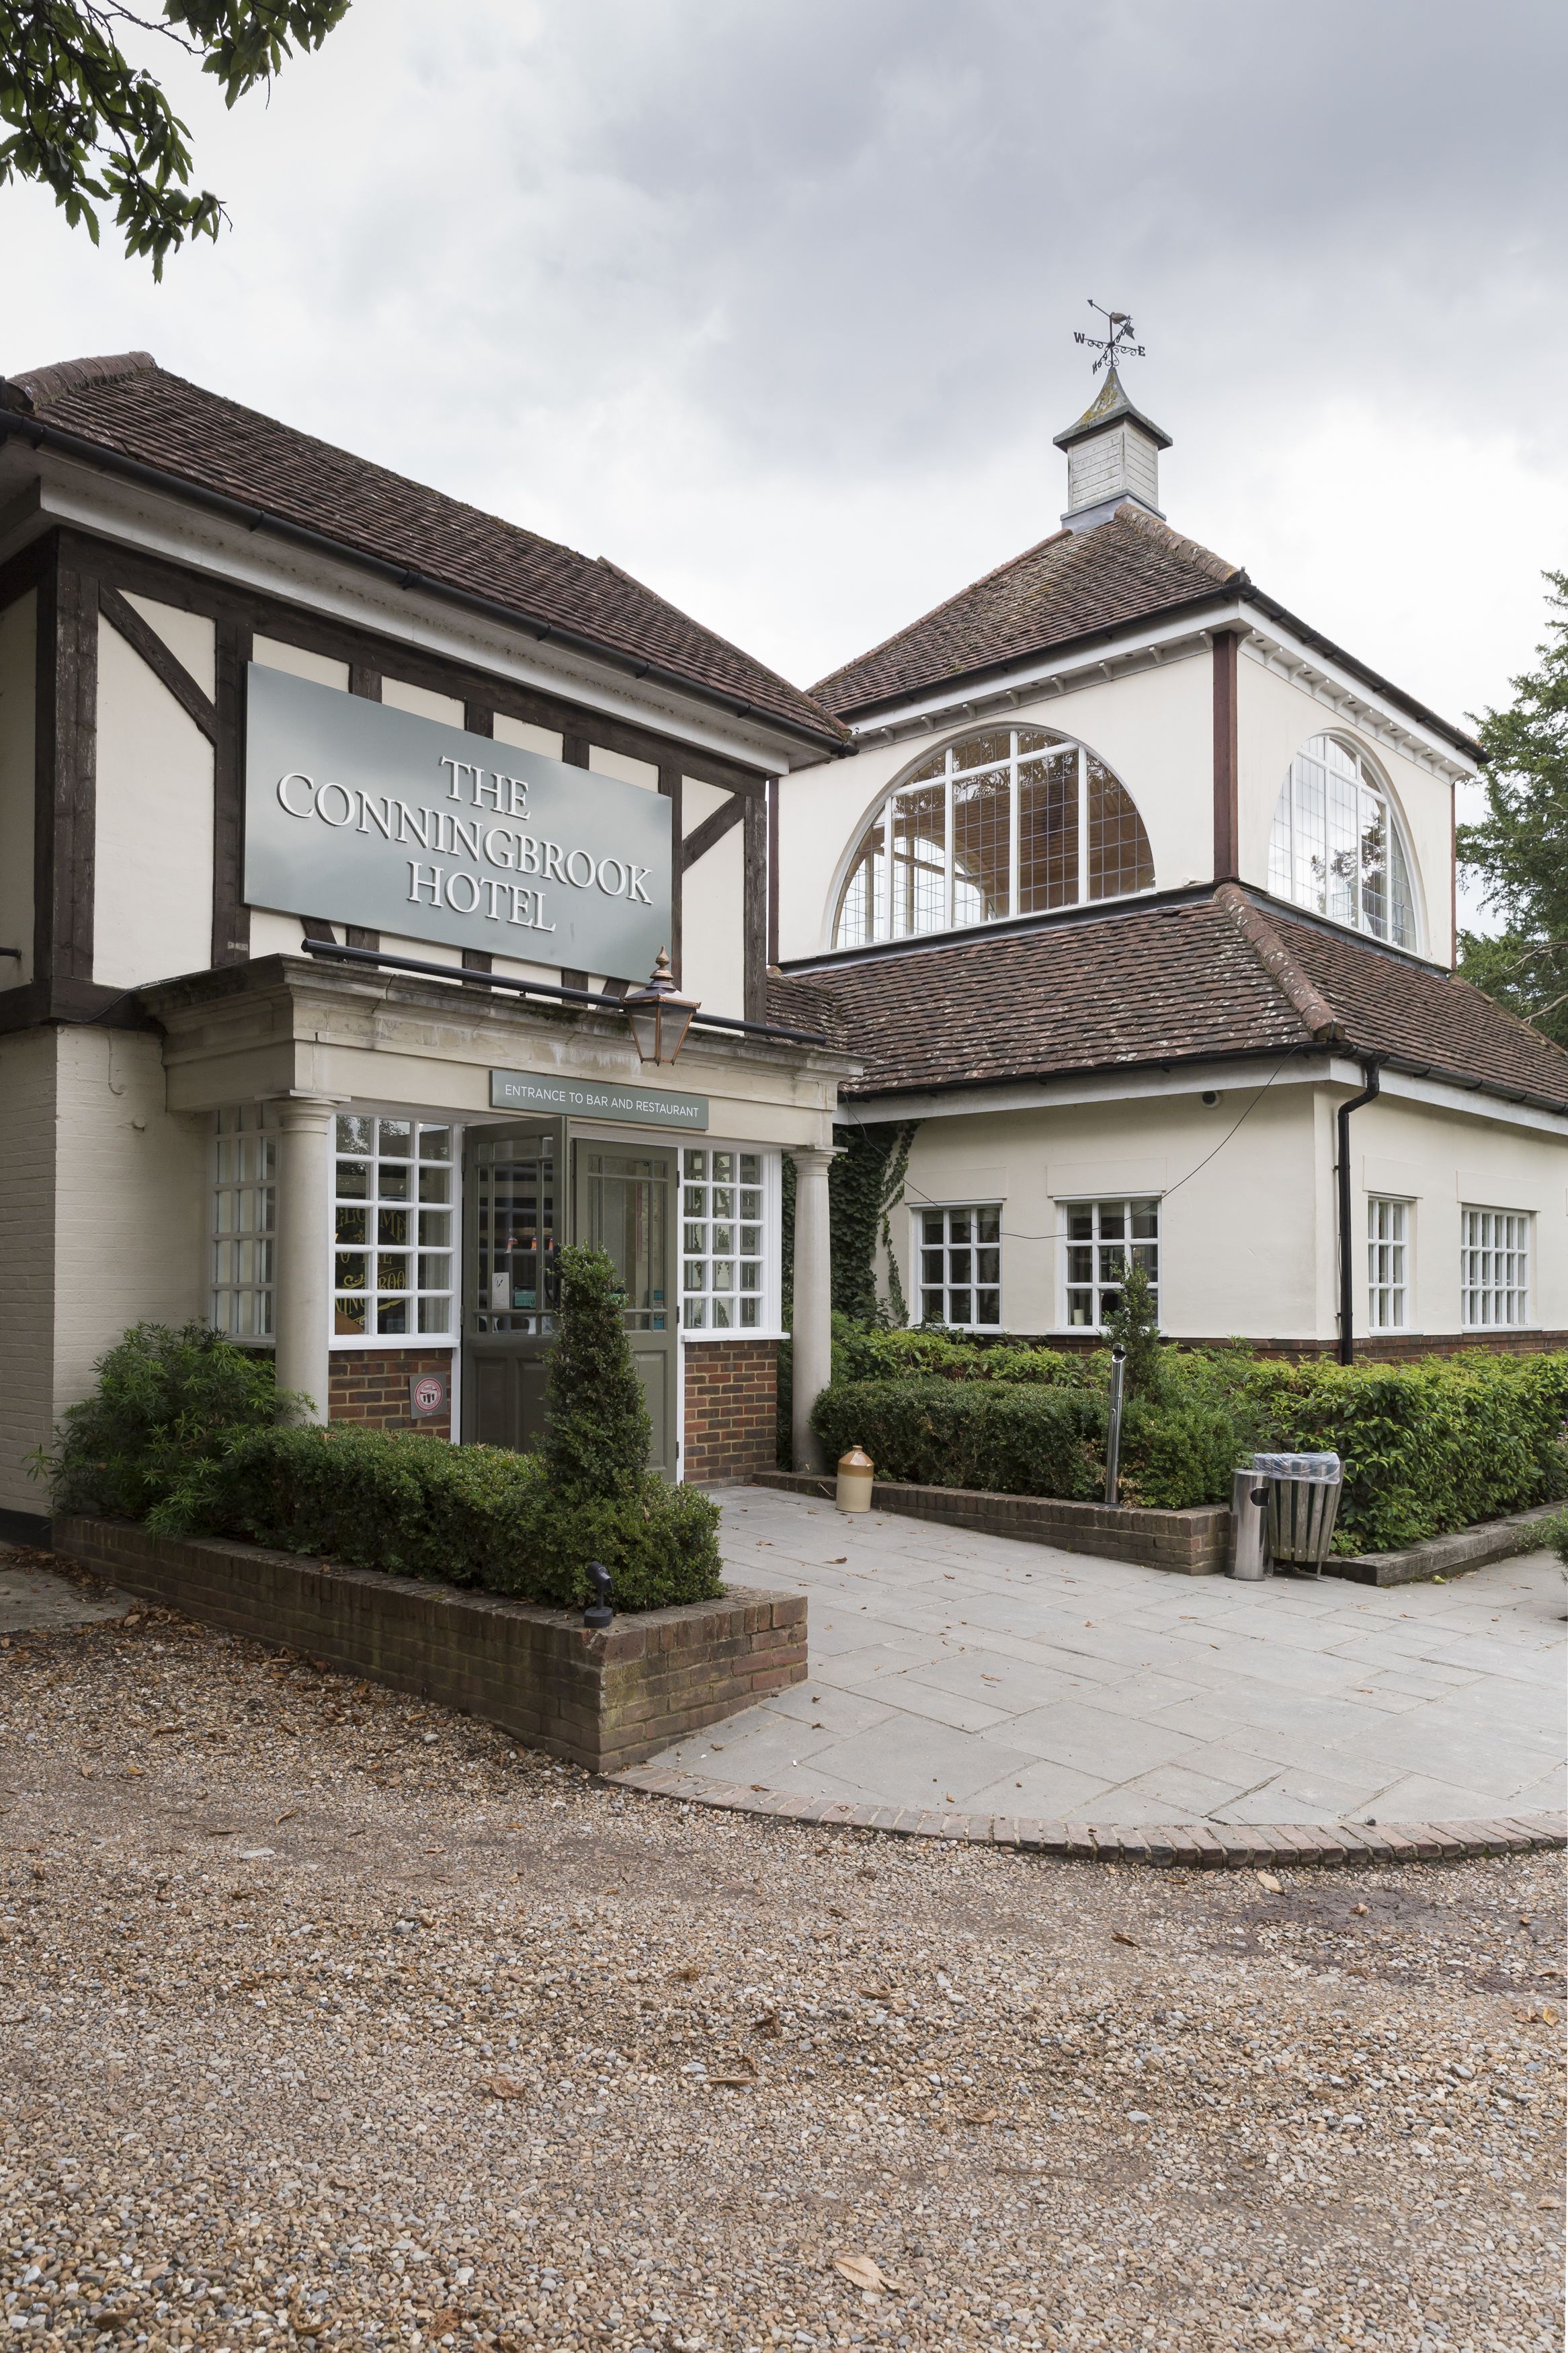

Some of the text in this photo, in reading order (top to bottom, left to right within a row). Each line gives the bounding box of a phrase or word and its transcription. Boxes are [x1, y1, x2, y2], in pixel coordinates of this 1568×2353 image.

[1073, 331, 1085, 344] W
[1138, 346, 1145, 356] E
[438, 754, 532, 821] THE
[276, 772, 654, 905] CONNINGBROOK
[406, 860, 556, 932] HOTEL
[505, 1084, 699, 1118] ENTRANCE TO BAR AND RESTAURANT
